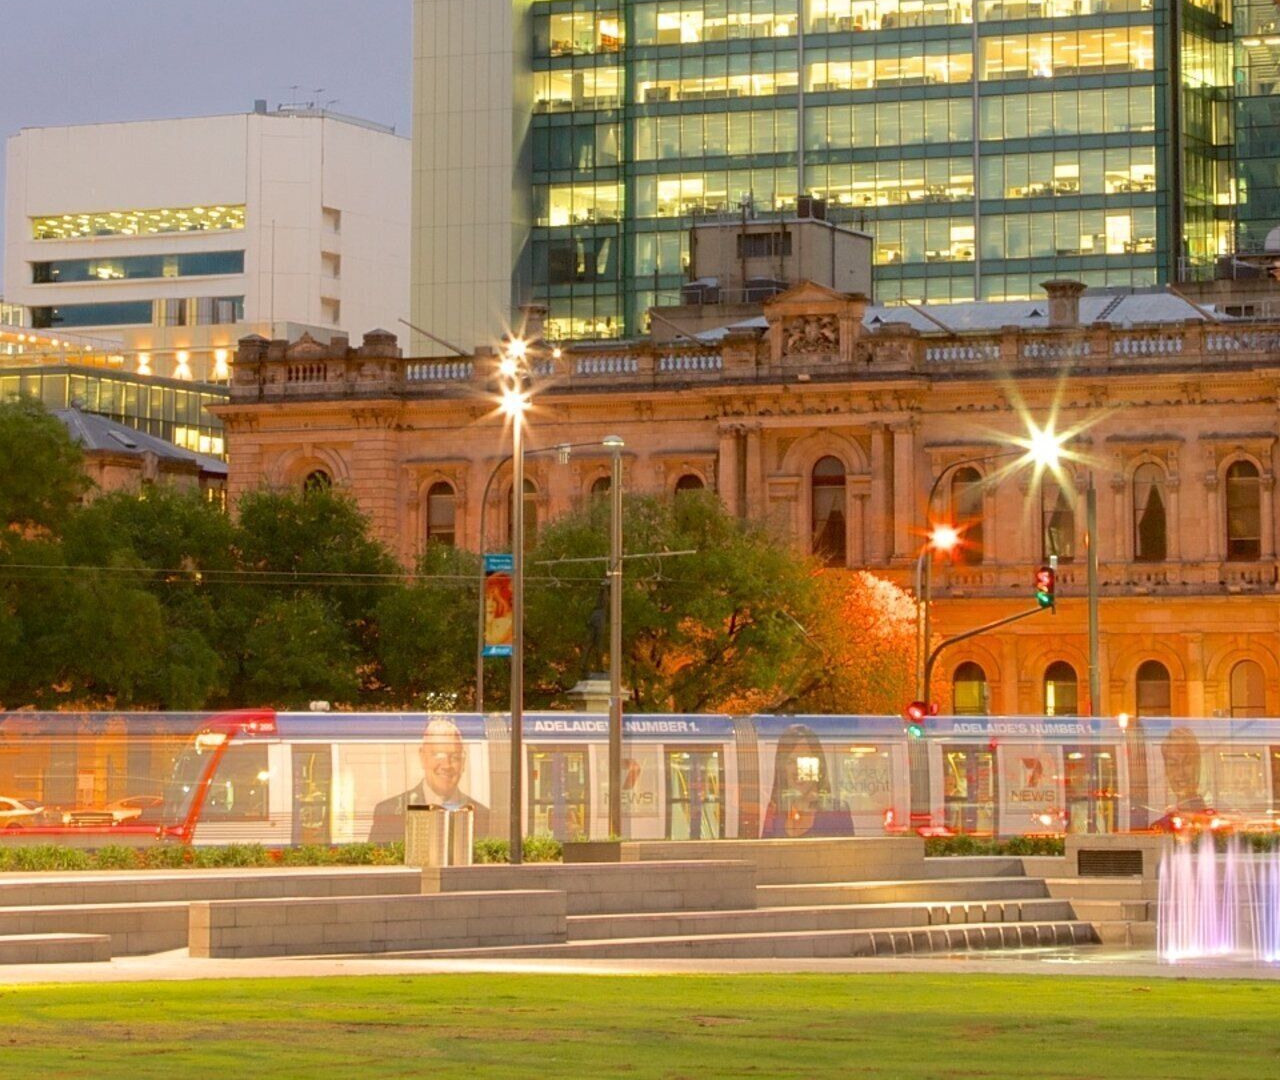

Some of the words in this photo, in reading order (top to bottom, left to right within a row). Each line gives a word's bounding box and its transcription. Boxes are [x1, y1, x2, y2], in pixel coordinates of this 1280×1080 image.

[534, 720, 609, 732] ADELAIDE'
[625, 721, 689, 733] NUMBER
[953, 723, 1027, 734] ADELAIDE'S
[1030, 723, 1086, 734] NUMBER
[1022, 758, 1043, 788] 7
[1011, 790, 1055, 802] NEWS
